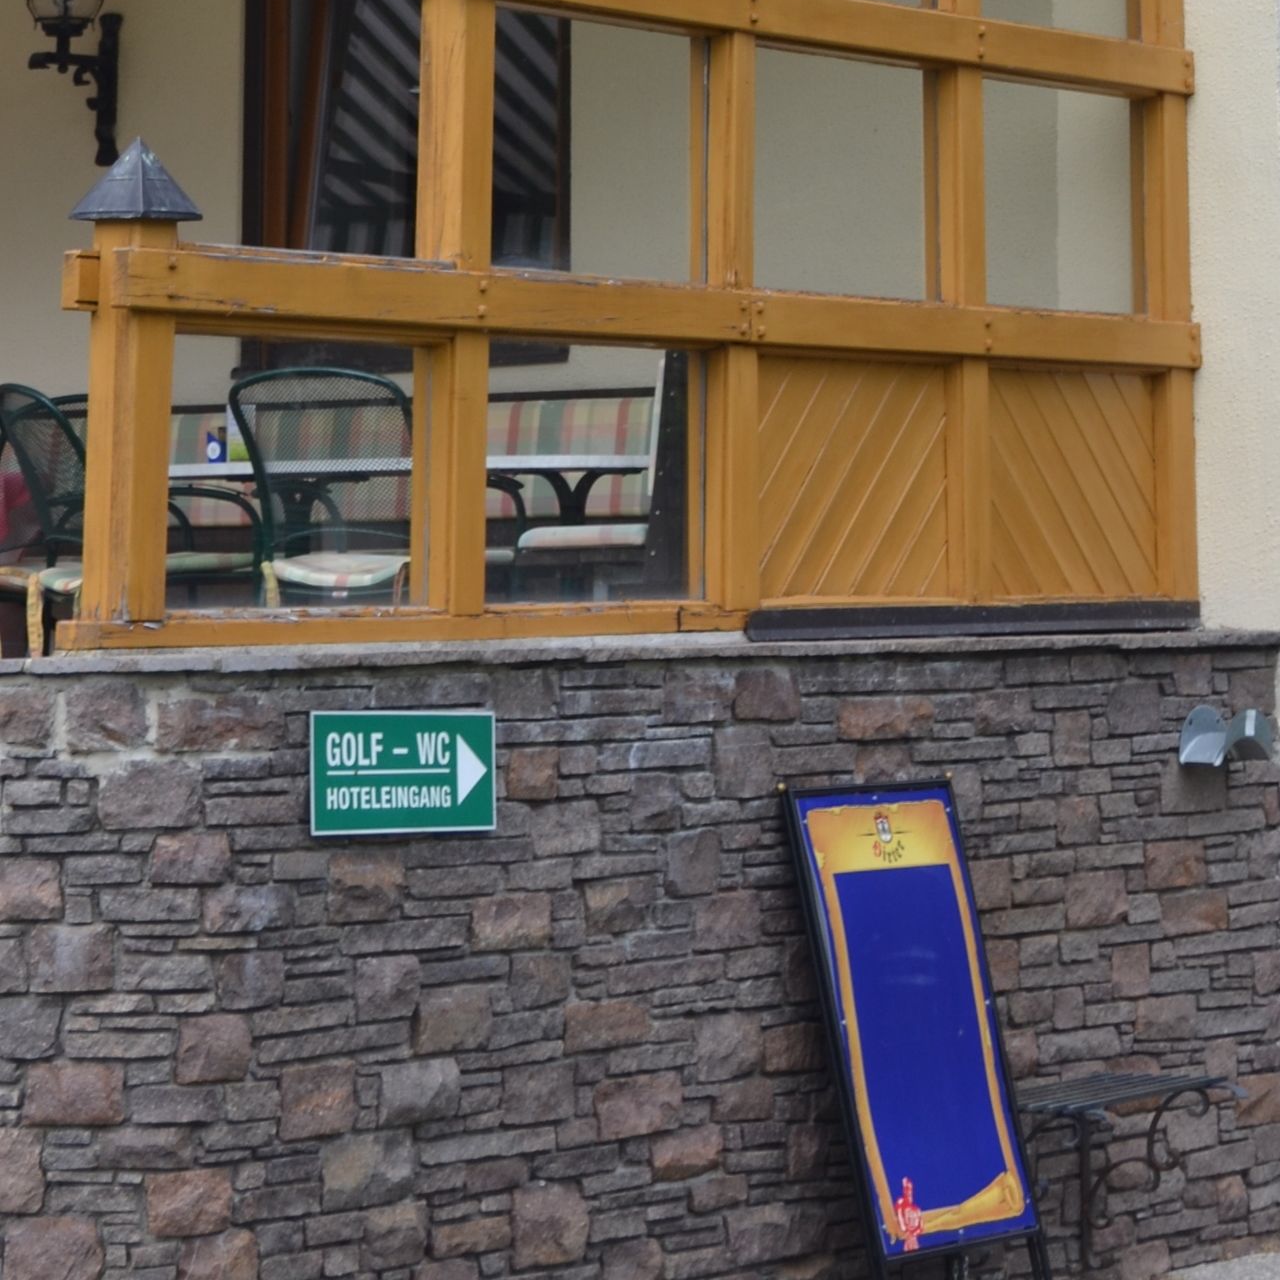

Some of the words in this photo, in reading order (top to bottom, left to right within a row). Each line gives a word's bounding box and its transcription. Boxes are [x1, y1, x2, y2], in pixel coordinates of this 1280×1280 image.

[325, 731, 384, 767] GOLF
[416, 731, 451, 766] WC
[325, 786, 452, 810] HOTELEINGANG
